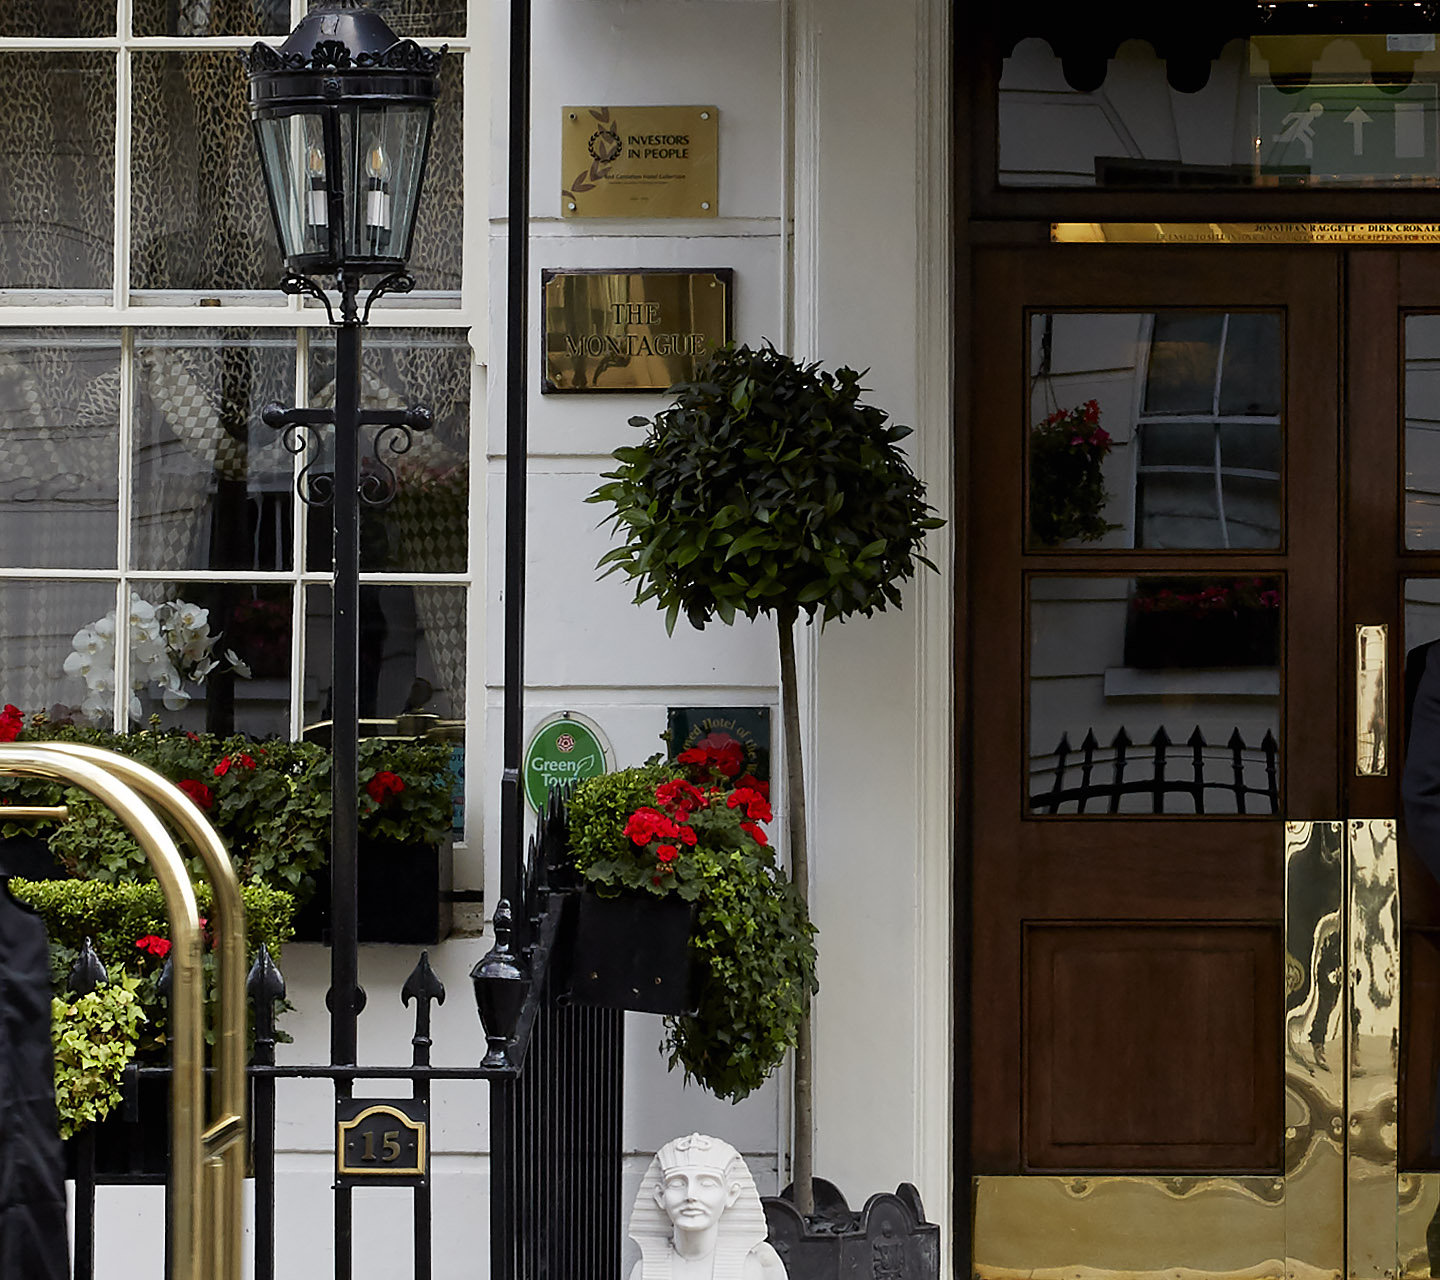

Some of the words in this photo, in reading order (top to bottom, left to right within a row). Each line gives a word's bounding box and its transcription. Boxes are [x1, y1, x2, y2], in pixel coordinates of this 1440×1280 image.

[628, 135, 689, 145] INVESTORS
[628, 149, 640, 158] IN
[644, 149, 689, 159] PEOPLE
[1310, 224, 1356, 232] RAGGETT
[1368, 224, 1393, 232] DIRK
[611, 303, 660, 325] THE
[565, 334, 706, 358] MONTAGUE
[702, 718, 736, 730] Hotel
[736, 727, 752, 739] of
[531, 756, 576, 771] Green
[541, 773, 590, 788] Tour
[360, 1130, 401, 1162] 15
